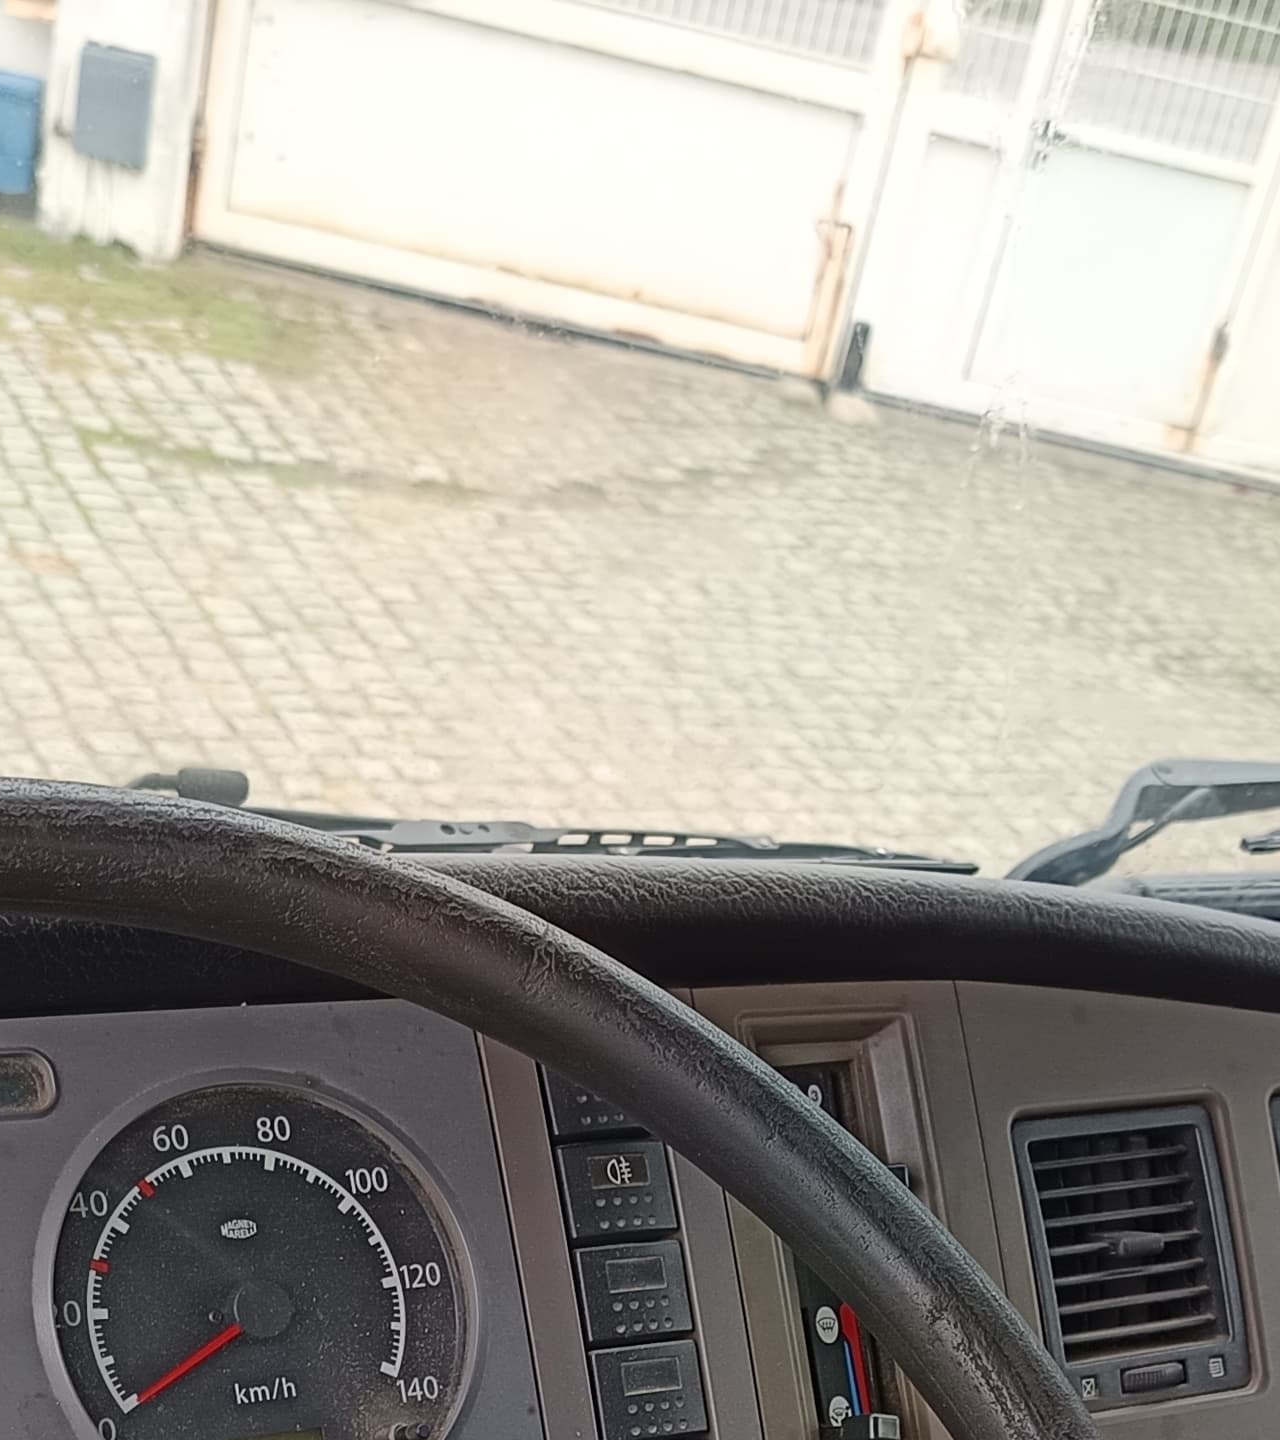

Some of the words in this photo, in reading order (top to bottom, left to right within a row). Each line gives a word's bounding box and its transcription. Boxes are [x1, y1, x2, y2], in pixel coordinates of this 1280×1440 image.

[152, 1124, 189, 1152] 60
[256, 1115, 291, 1143] 80
[345, 1166, 389, 1195] 100
[69, 1190, 108, 1218] 40
[400, 1264, 441, 1290] 120
[234, 1377, 297, 1405] km/h
[396, 1375, 439, 1403] 140
